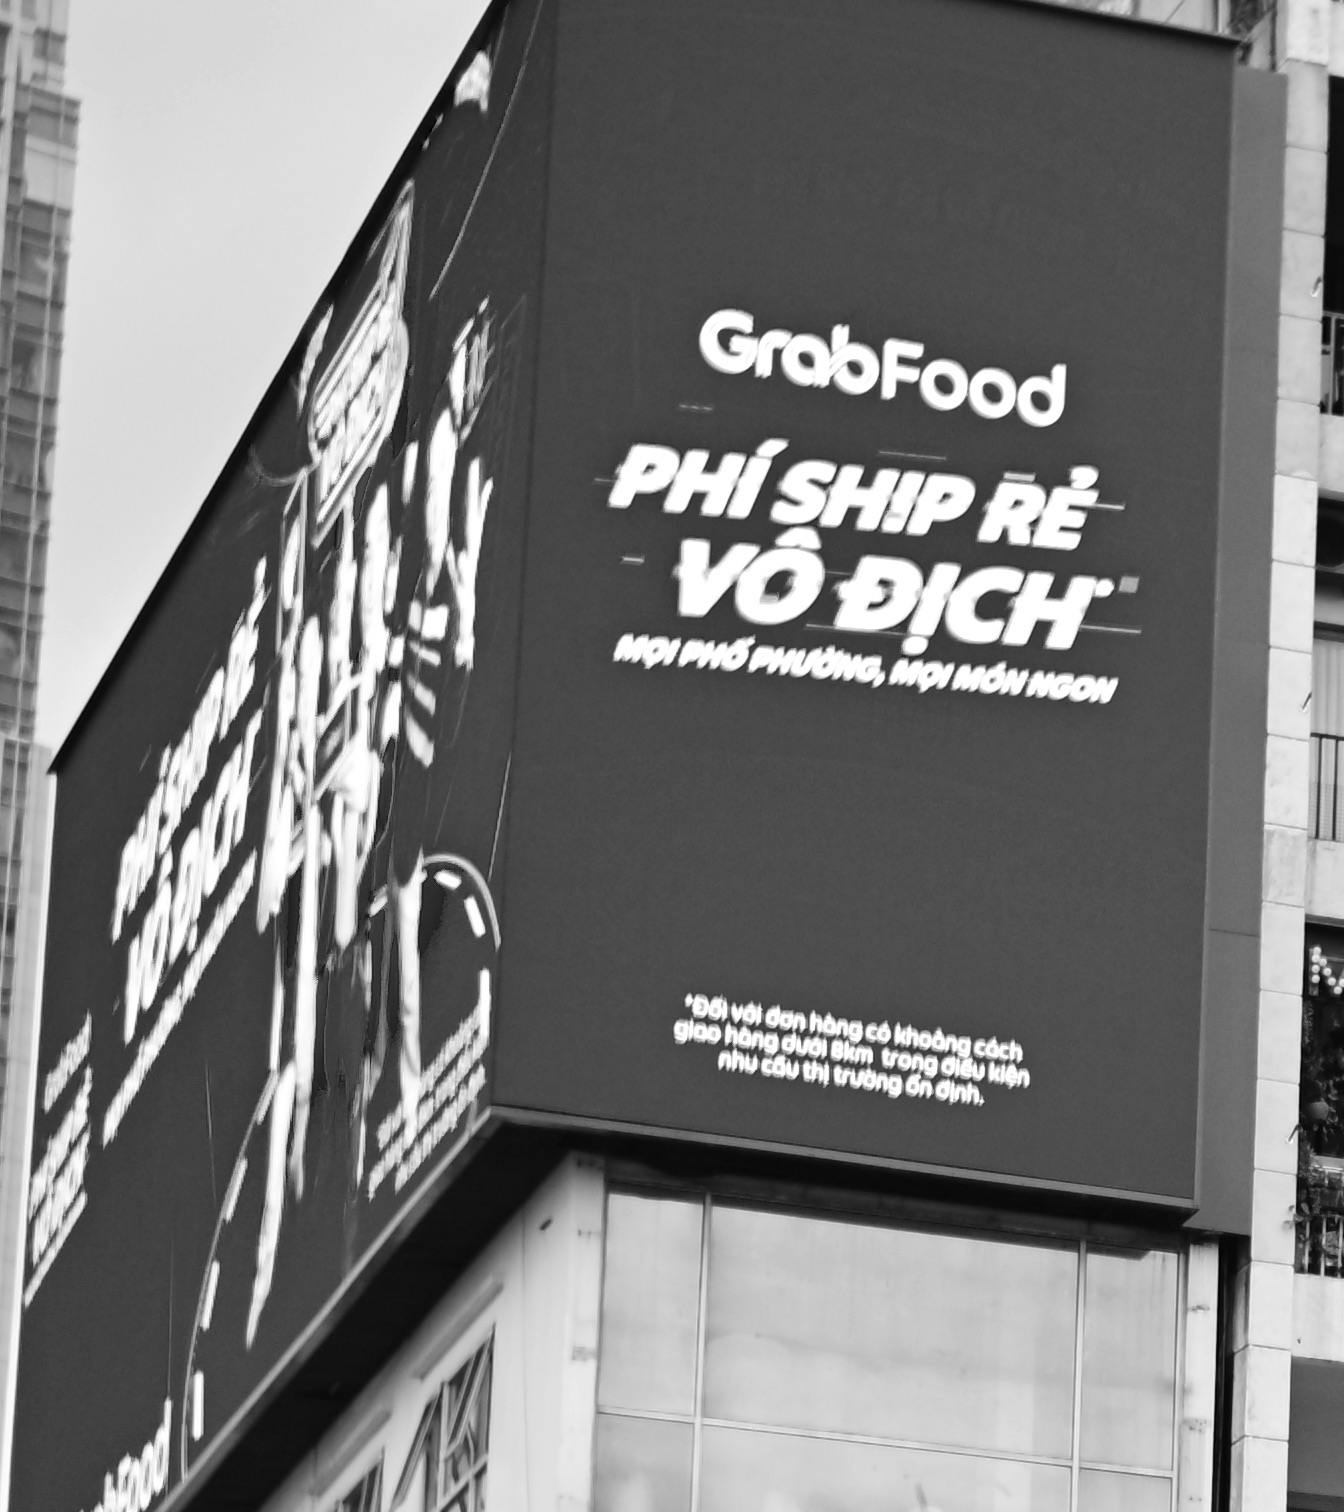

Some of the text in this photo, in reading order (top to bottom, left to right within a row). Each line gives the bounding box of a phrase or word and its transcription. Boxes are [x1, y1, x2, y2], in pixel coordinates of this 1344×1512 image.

[699, 308, 1067, 427] GrabFood
[608, 438, 1100, 551] PHÍ SHIP RẺ
[675, 526, 826, 626] VÔ
[613, 633, 679, 669] MỌI
[678, 635, 756, 673] PHỐ
[888, 658, 955, 693] MỌI
[953, 661, 1031, 697] MÓN
[1025, 670, 1119, 705] NGON
